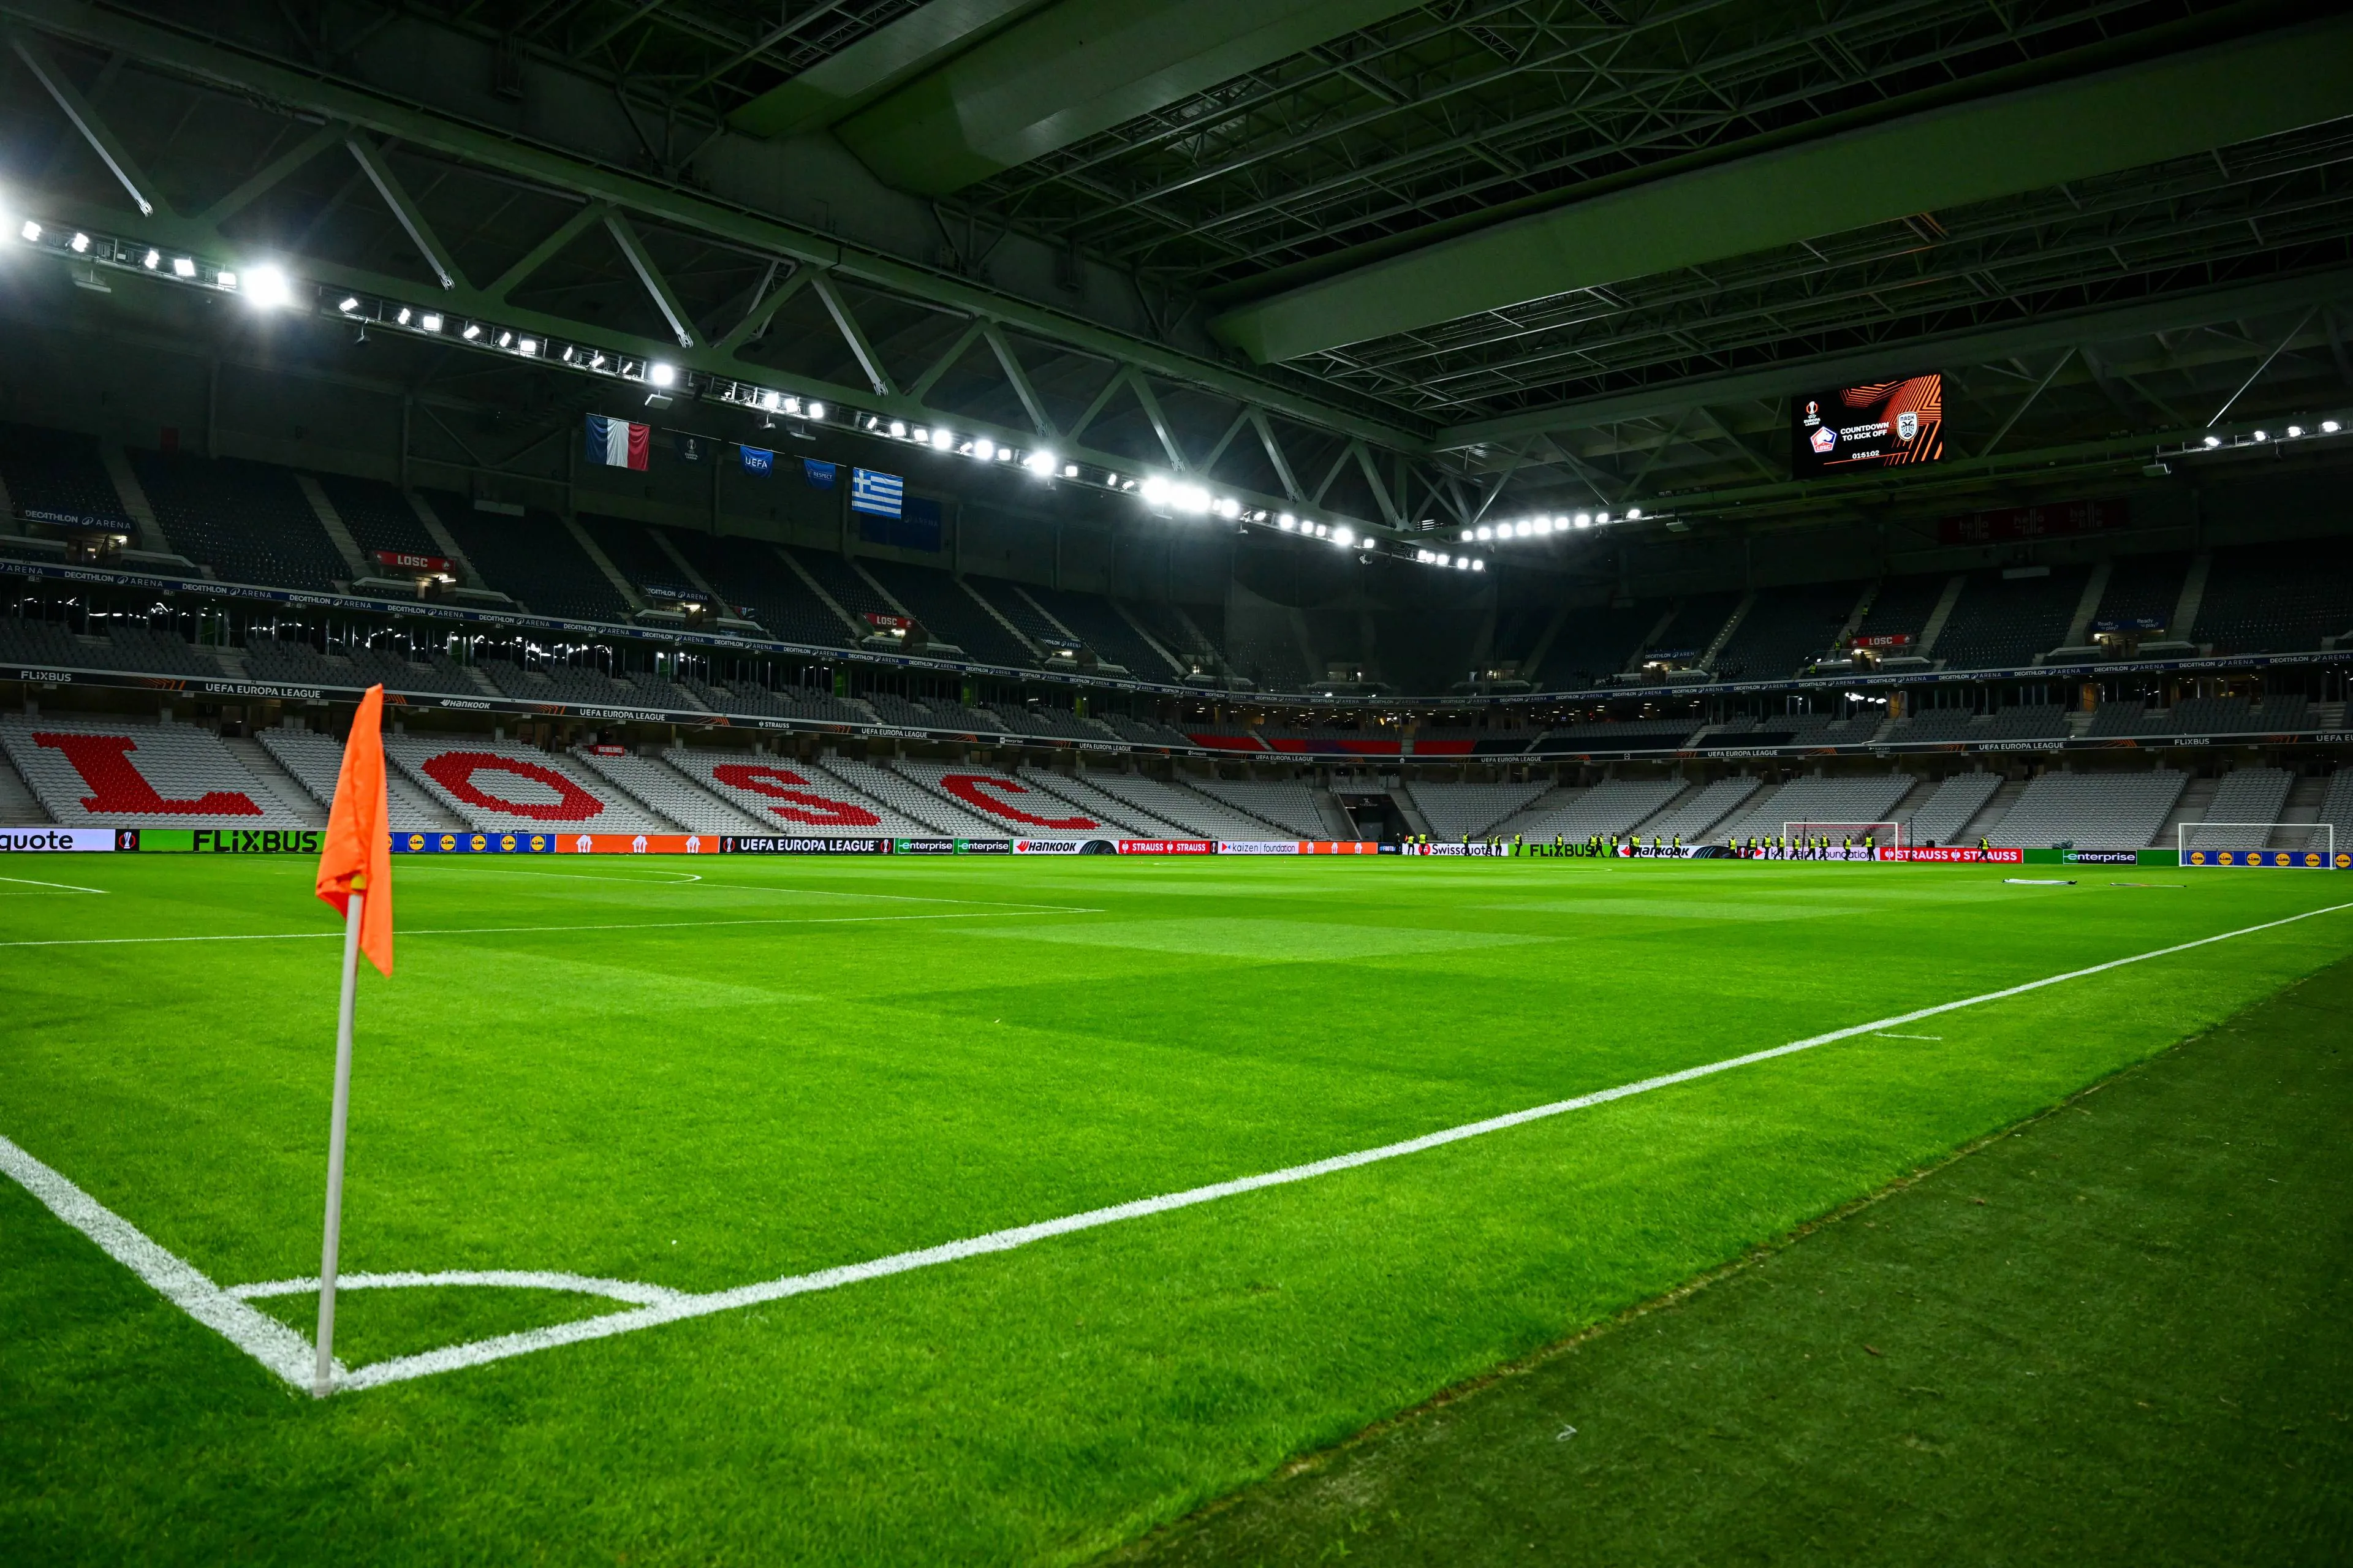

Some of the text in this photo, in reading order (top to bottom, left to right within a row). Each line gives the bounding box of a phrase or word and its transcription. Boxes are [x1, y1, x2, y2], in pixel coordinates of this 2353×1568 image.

[1840, 422, 1890, 435] COUNTDOWN
[1854, 431, 1871, 440] KICK
[745, 455, 768, 468] UEFA
[813, 471, 833, 480] RESPECT
[25, 510, 131, 529] DECATHLON ARENA
[397, 554, 428, 568] LOSC
[7, 566, 44, 575] ARENA
[64, 571, 164, 588] DECATHLON ARENA
[182, 583, 227, 594] DECATHLON
[241, 590, 272, 599] ARENA
[289, 594, 331, 605] DECATHLON
[387, 605, 464, 618] DECATHLON ARENA
[479, 614, 515, 624] DECATHLON
[876, 615, 898, 626] LOSC
[563, 623, 596, 632] DECATHLON
[642, 632, 673, 640] DECATHLON
[1868, 637, 1893, 645] LOSC
[714, 639, 743, 648] DECATHLON
[205, 683, 322, 699] UEFA EUROPA LEAGUE
[580, 708, 665, 721] UEFA EUROPA LEAGUE
[0, 831, 74, 850] quote
[740, 838, 875, 852] UEFA EUROPA LEAGUE
[902, 841, 952, 852] enterprise
[961, 842, 1009, 852] enterprise
[1132, 843, 1164, 851] STRAUSS
[1232, 843, 1295, 852] kaizen foundation
[1898, 850, 1948, 860] STRAUSS
[2067, 852, 2135, 863] enterprise
